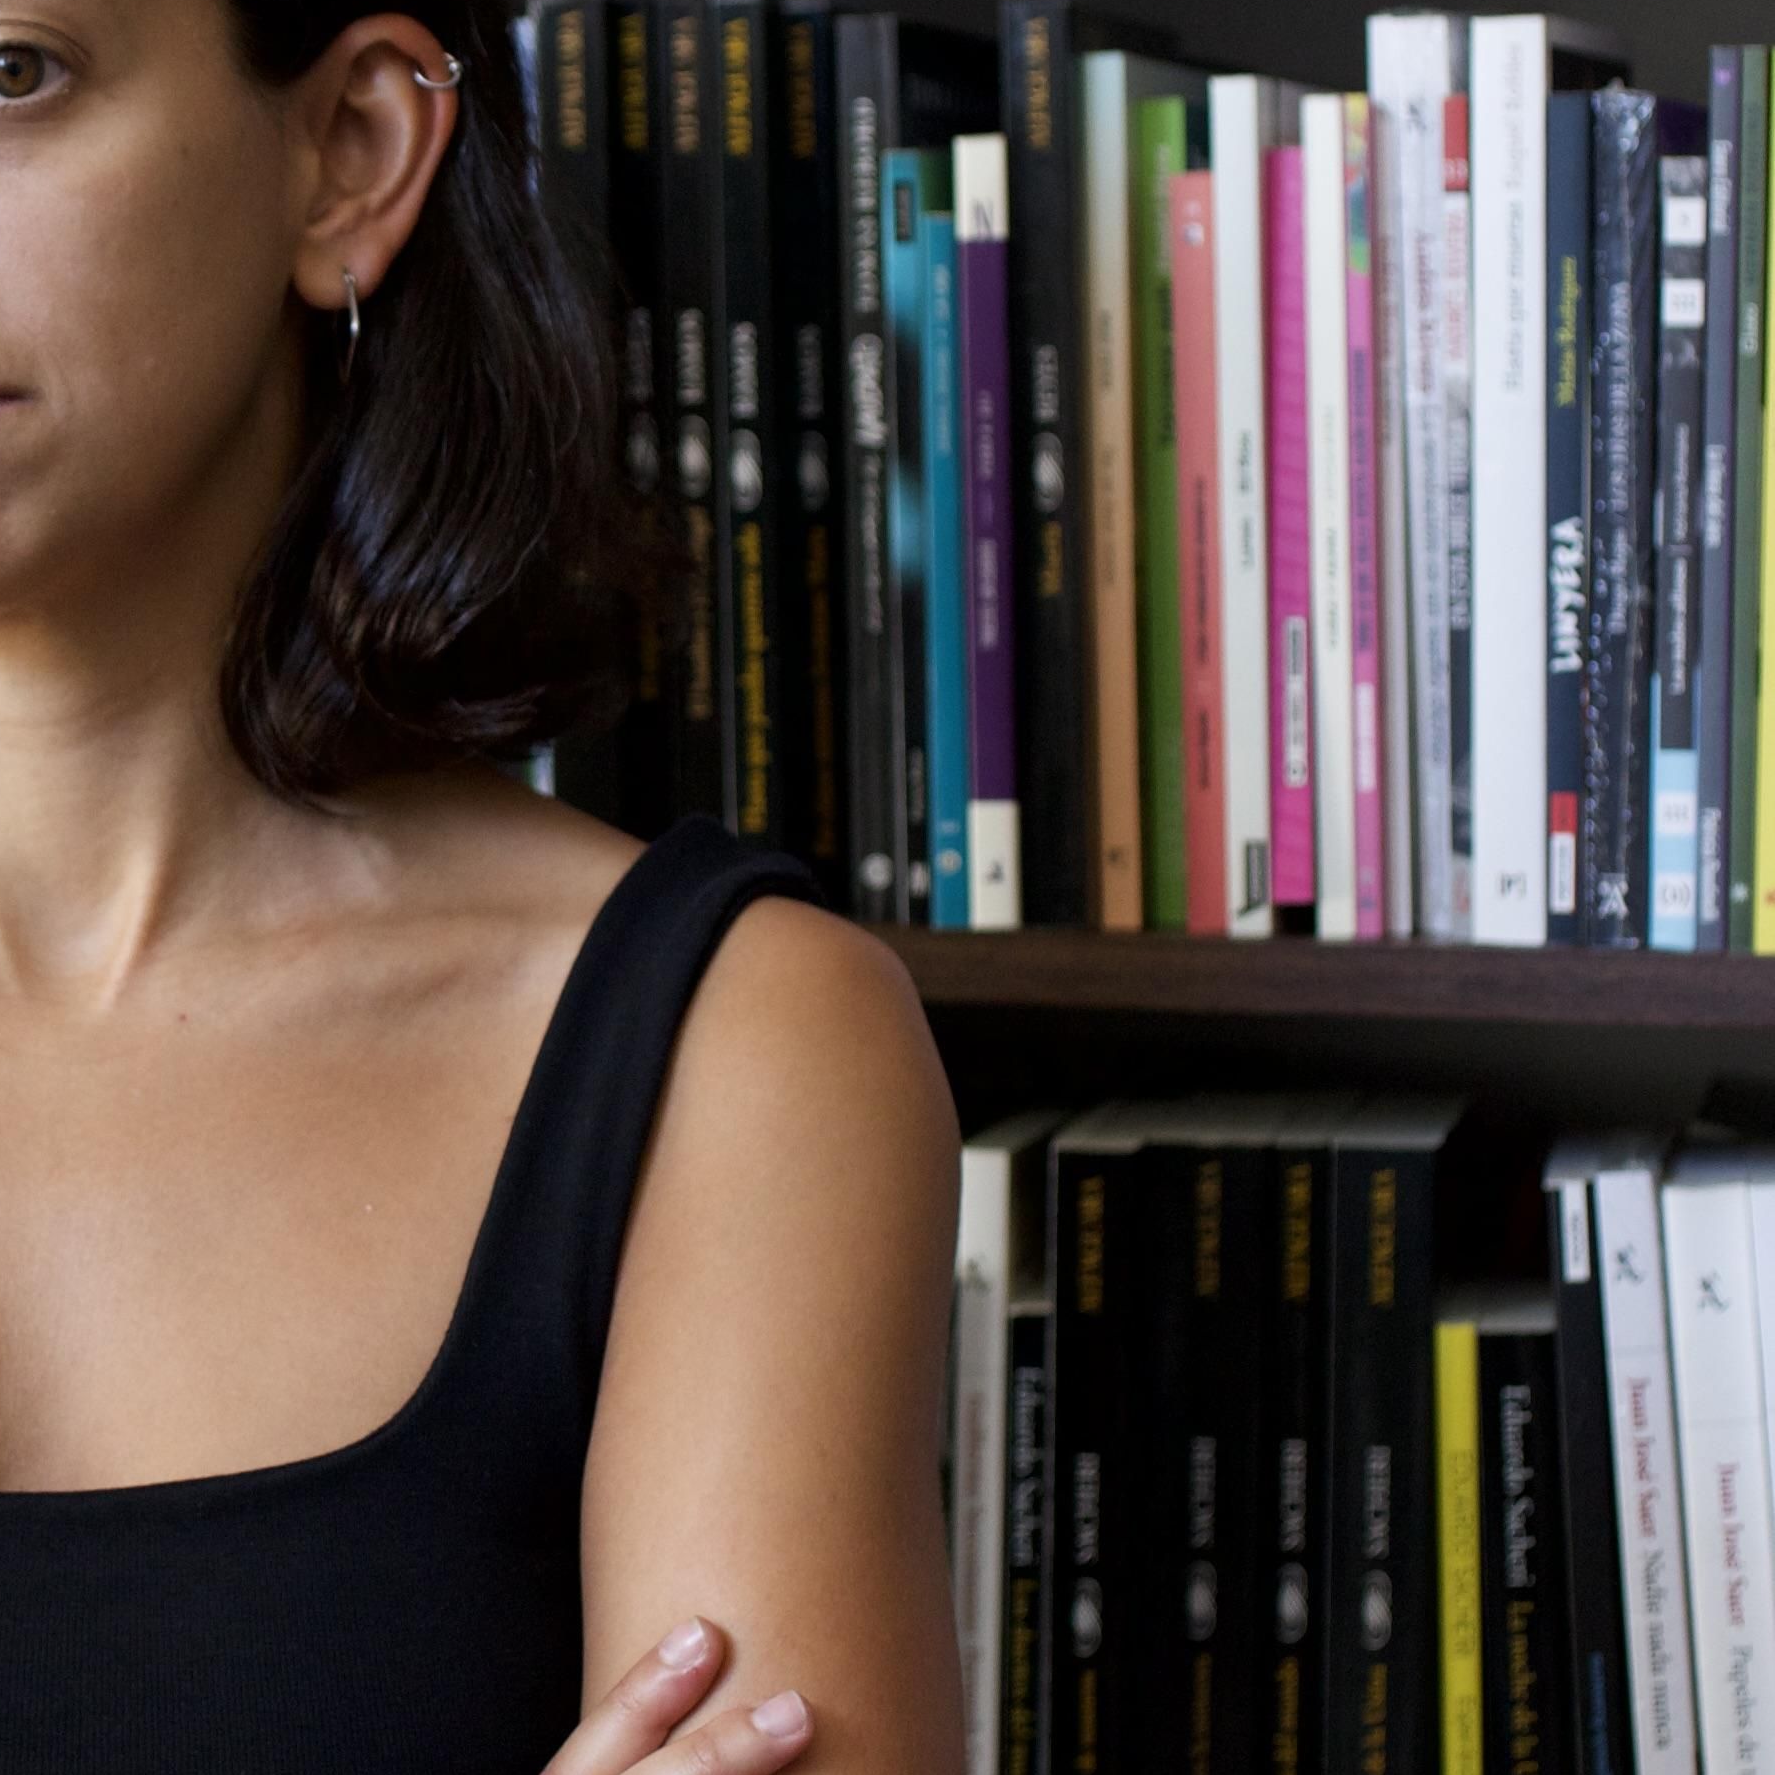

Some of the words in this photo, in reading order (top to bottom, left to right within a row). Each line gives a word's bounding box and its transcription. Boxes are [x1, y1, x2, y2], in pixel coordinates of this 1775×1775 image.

[1549, 515, 1585, 675] LINYERA
[1626, 1376, 1650, 1431] Juan
[1499, 1384, 1532, 1494] Eduardo
[1634, 1490, 1659, 1538] Saer
[1714, 1462, 1740, 1516] Juan
[1504, 1497, 1536, 1588] Sacheri
[1724, 1577, 1747, 1627] Saer
